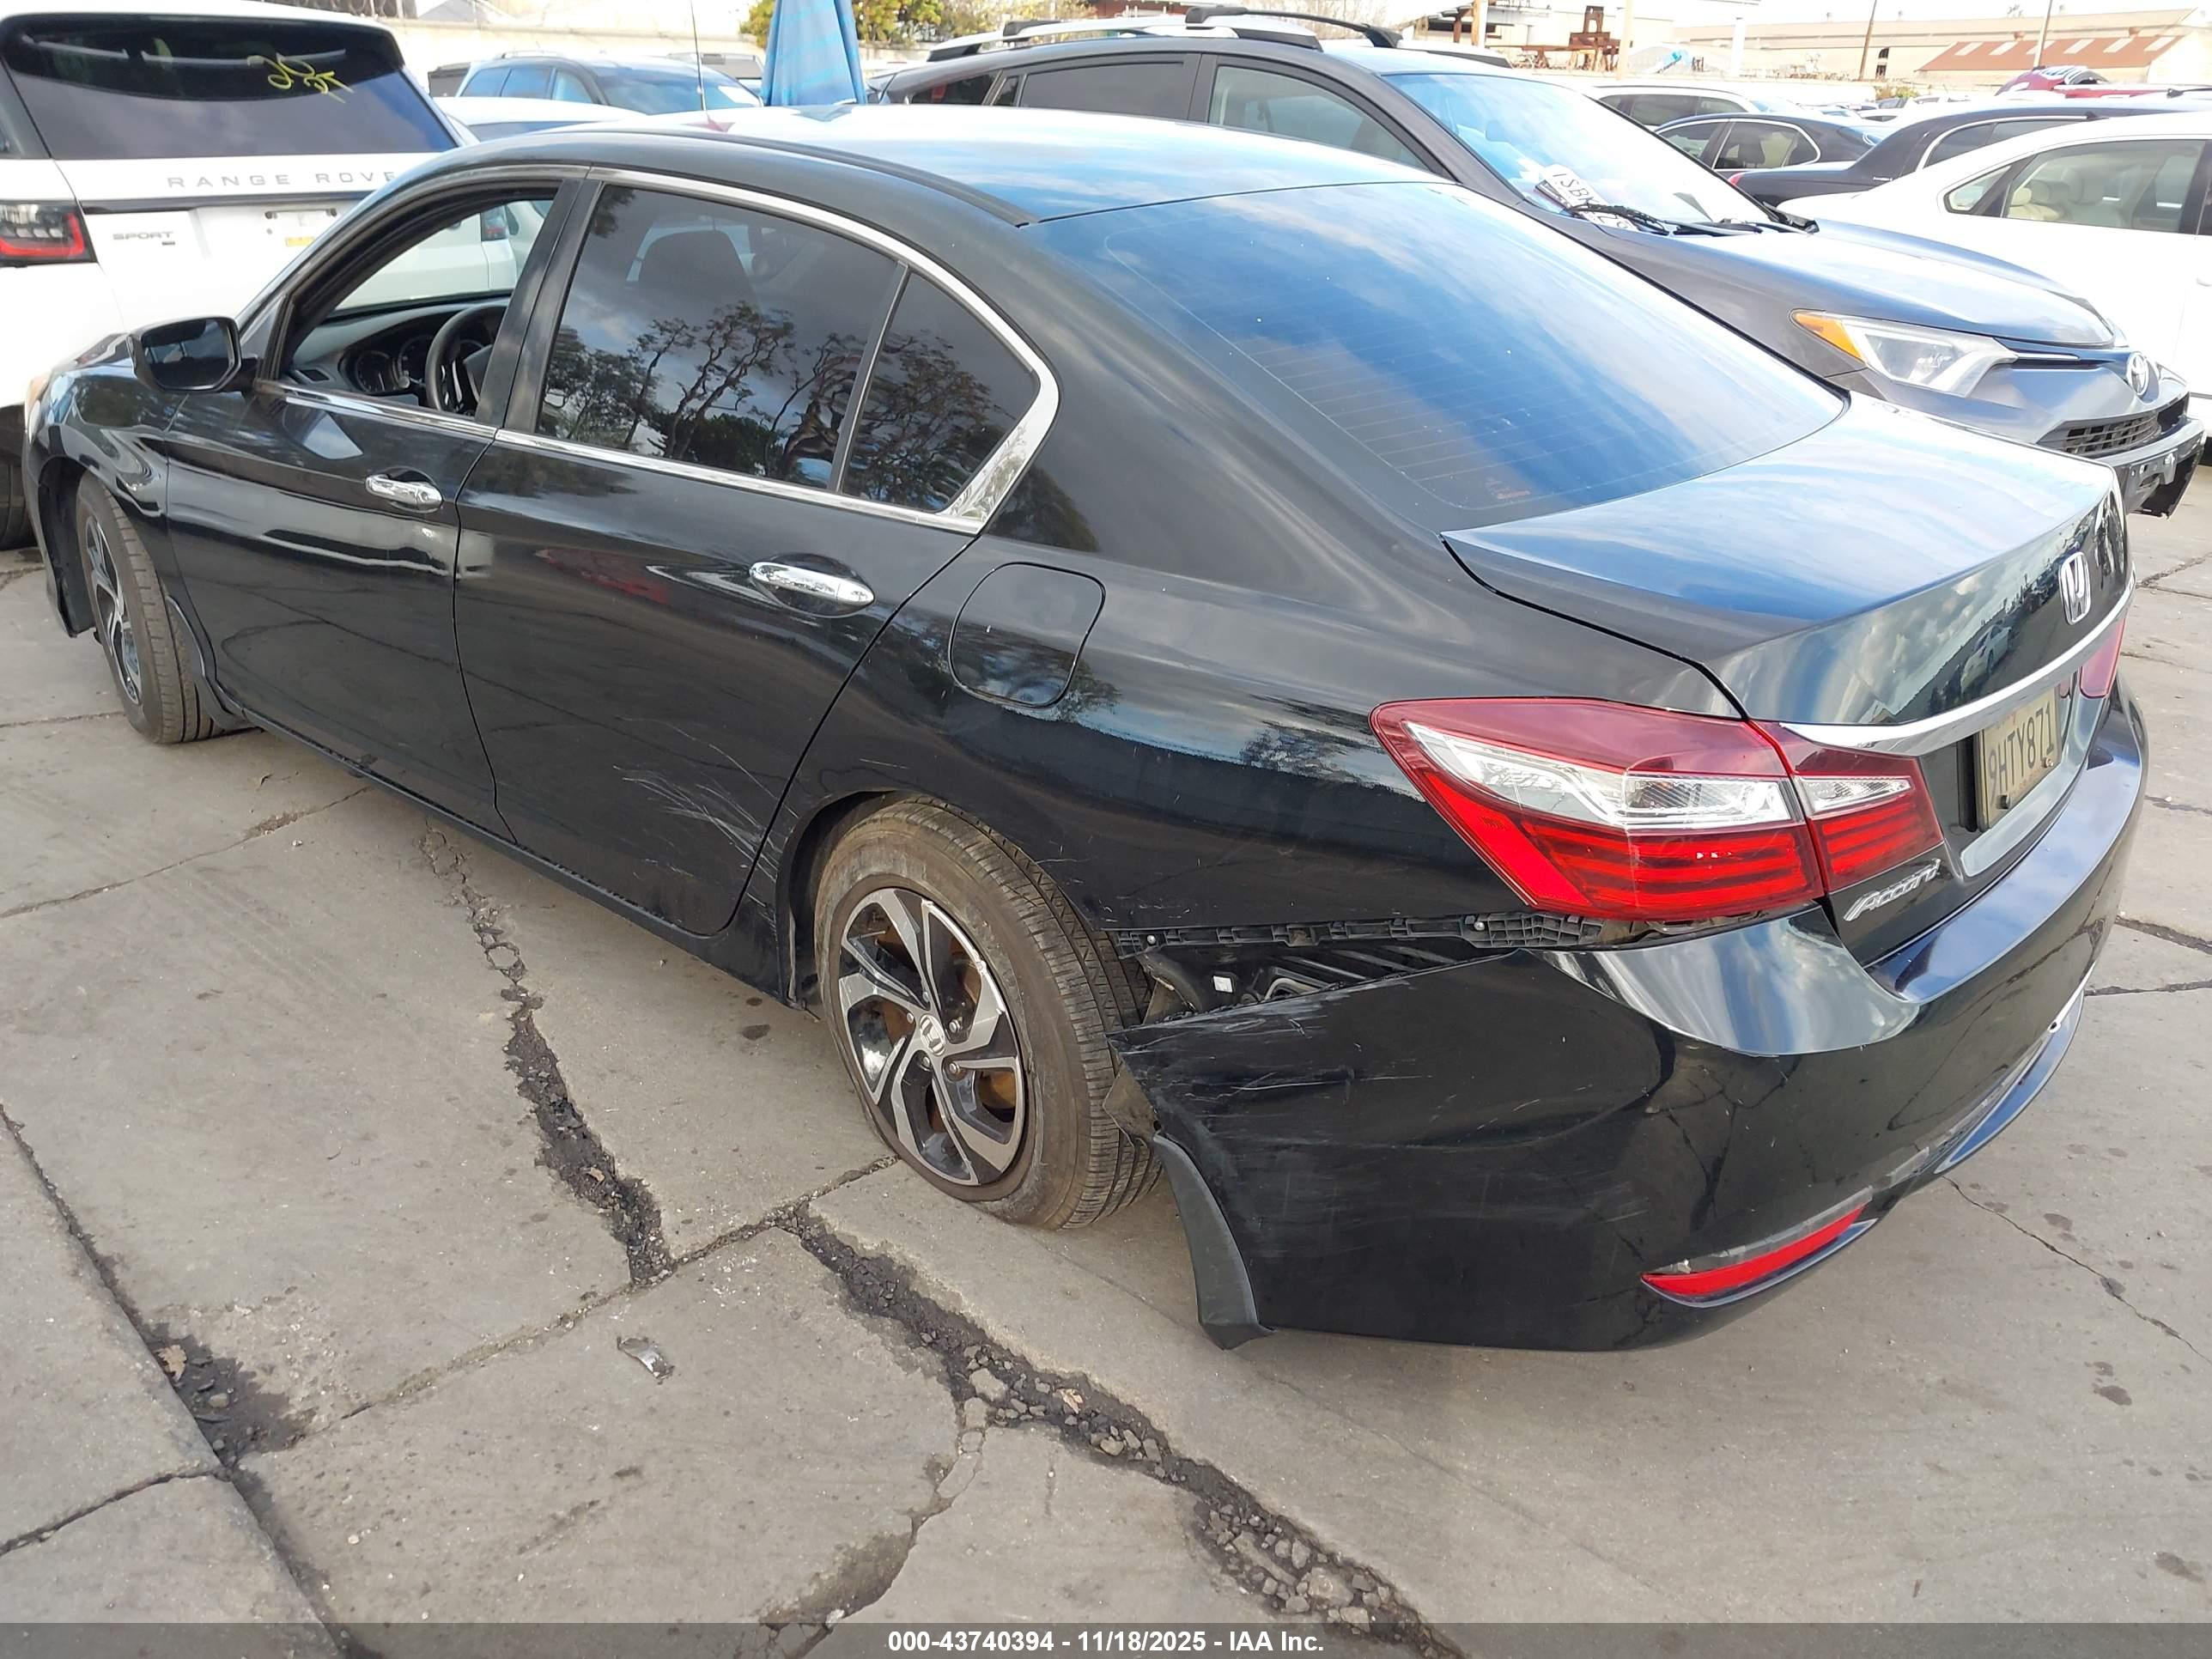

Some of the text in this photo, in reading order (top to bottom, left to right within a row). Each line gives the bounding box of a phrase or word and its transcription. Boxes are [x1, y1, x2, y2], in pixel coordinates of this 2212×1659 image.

[167, 172, 398, 187] RANGE ROVE
[112, 230, 173, 240] SPORT
[1988, 702, 2055, 809] 9HTY871
[1843, 858, 1942, 921] Accord
